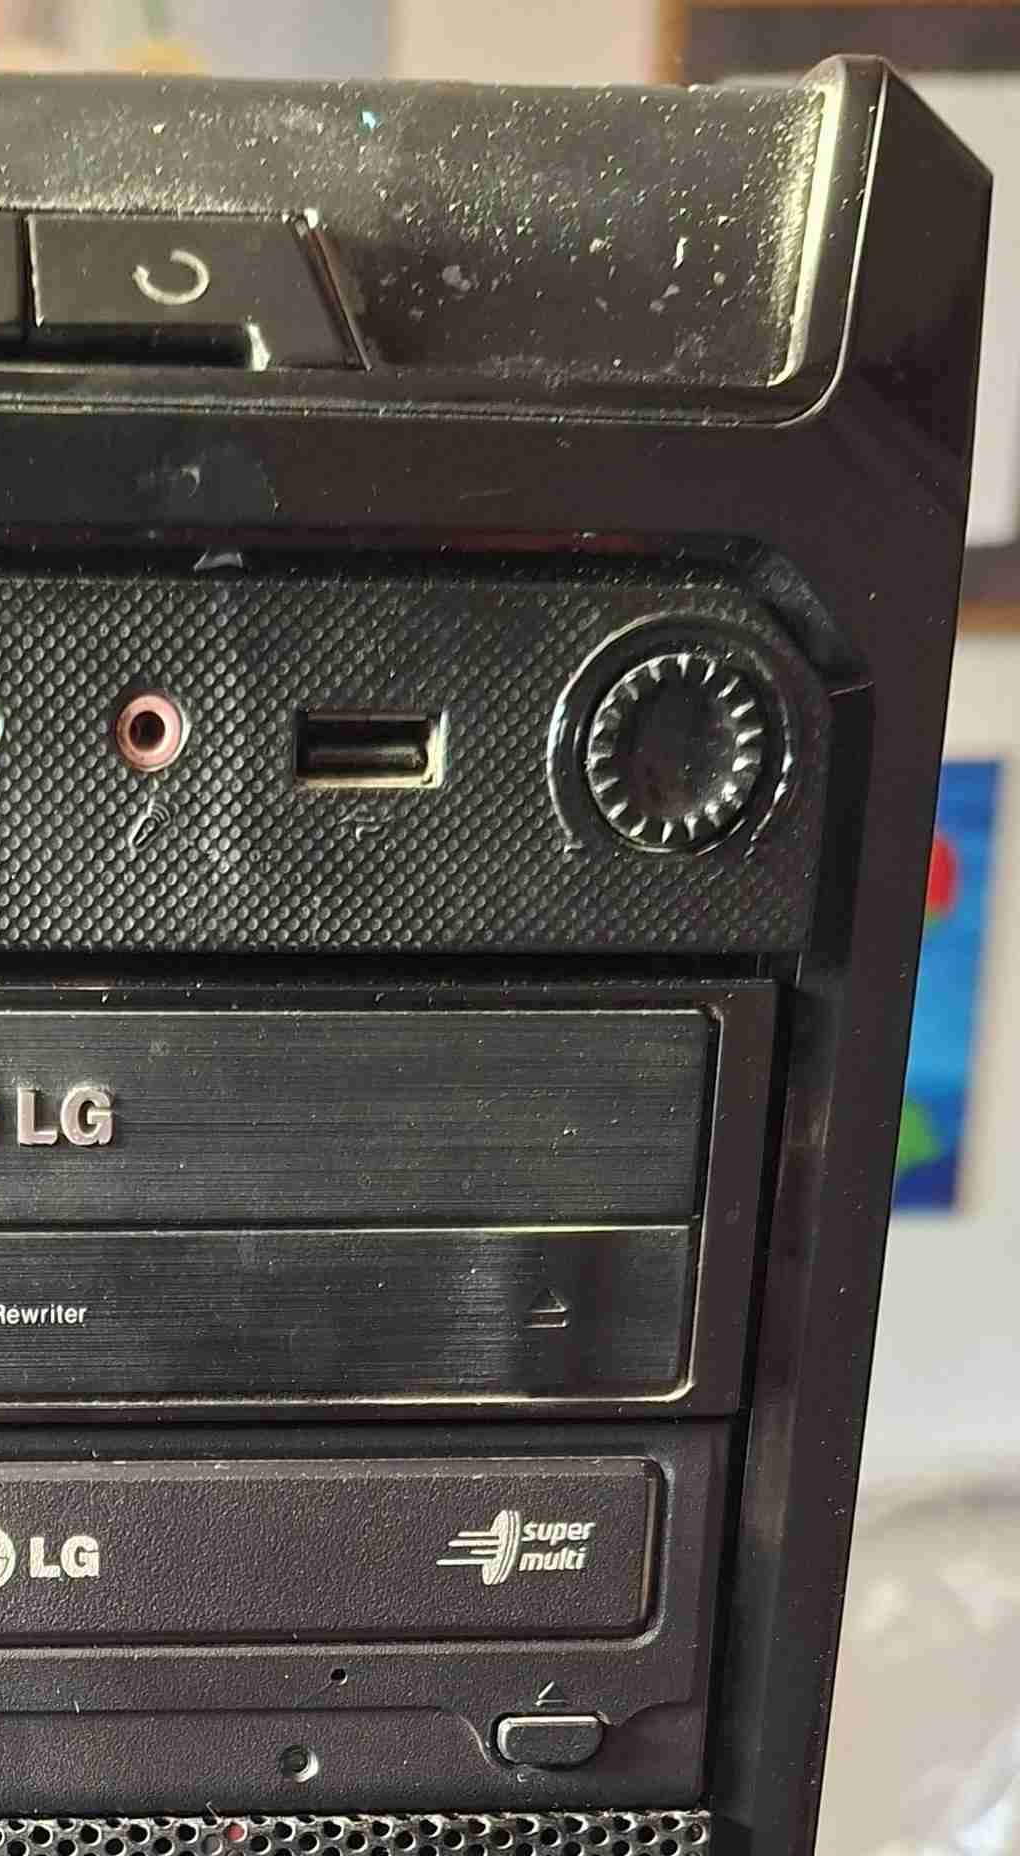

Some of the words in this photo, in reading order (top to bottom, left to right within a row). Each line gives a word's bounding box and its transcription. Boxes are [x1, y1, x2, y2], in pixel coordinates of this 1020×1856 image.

[17, 1086, 114, 1146] LG
[520, 1521, 596, 1546] super
[30, 1535, 101, 1578] LG
[518, 1546, 587, 1571] multi
